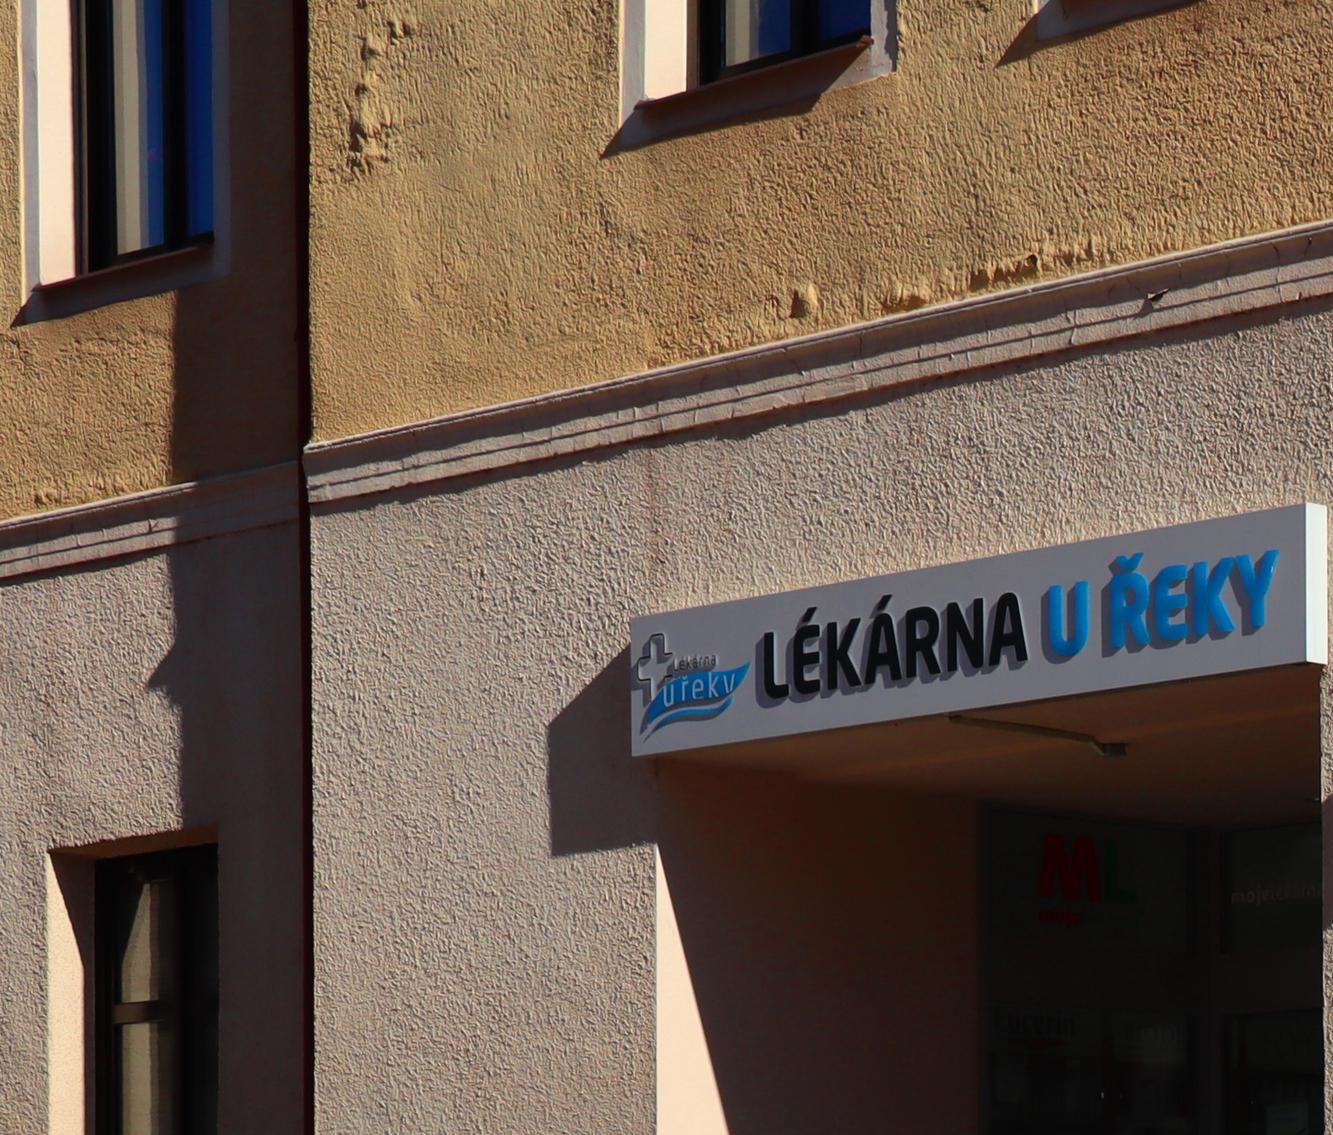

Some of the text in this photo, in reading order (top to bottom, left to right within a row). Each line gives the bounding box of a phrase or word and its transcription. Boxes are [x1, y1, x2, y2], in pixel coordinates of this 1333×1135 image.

[674, 654, 717, 672] Lékárna
[763, 549, 1280, 700] LÉKÁRNA U ŘEKY
